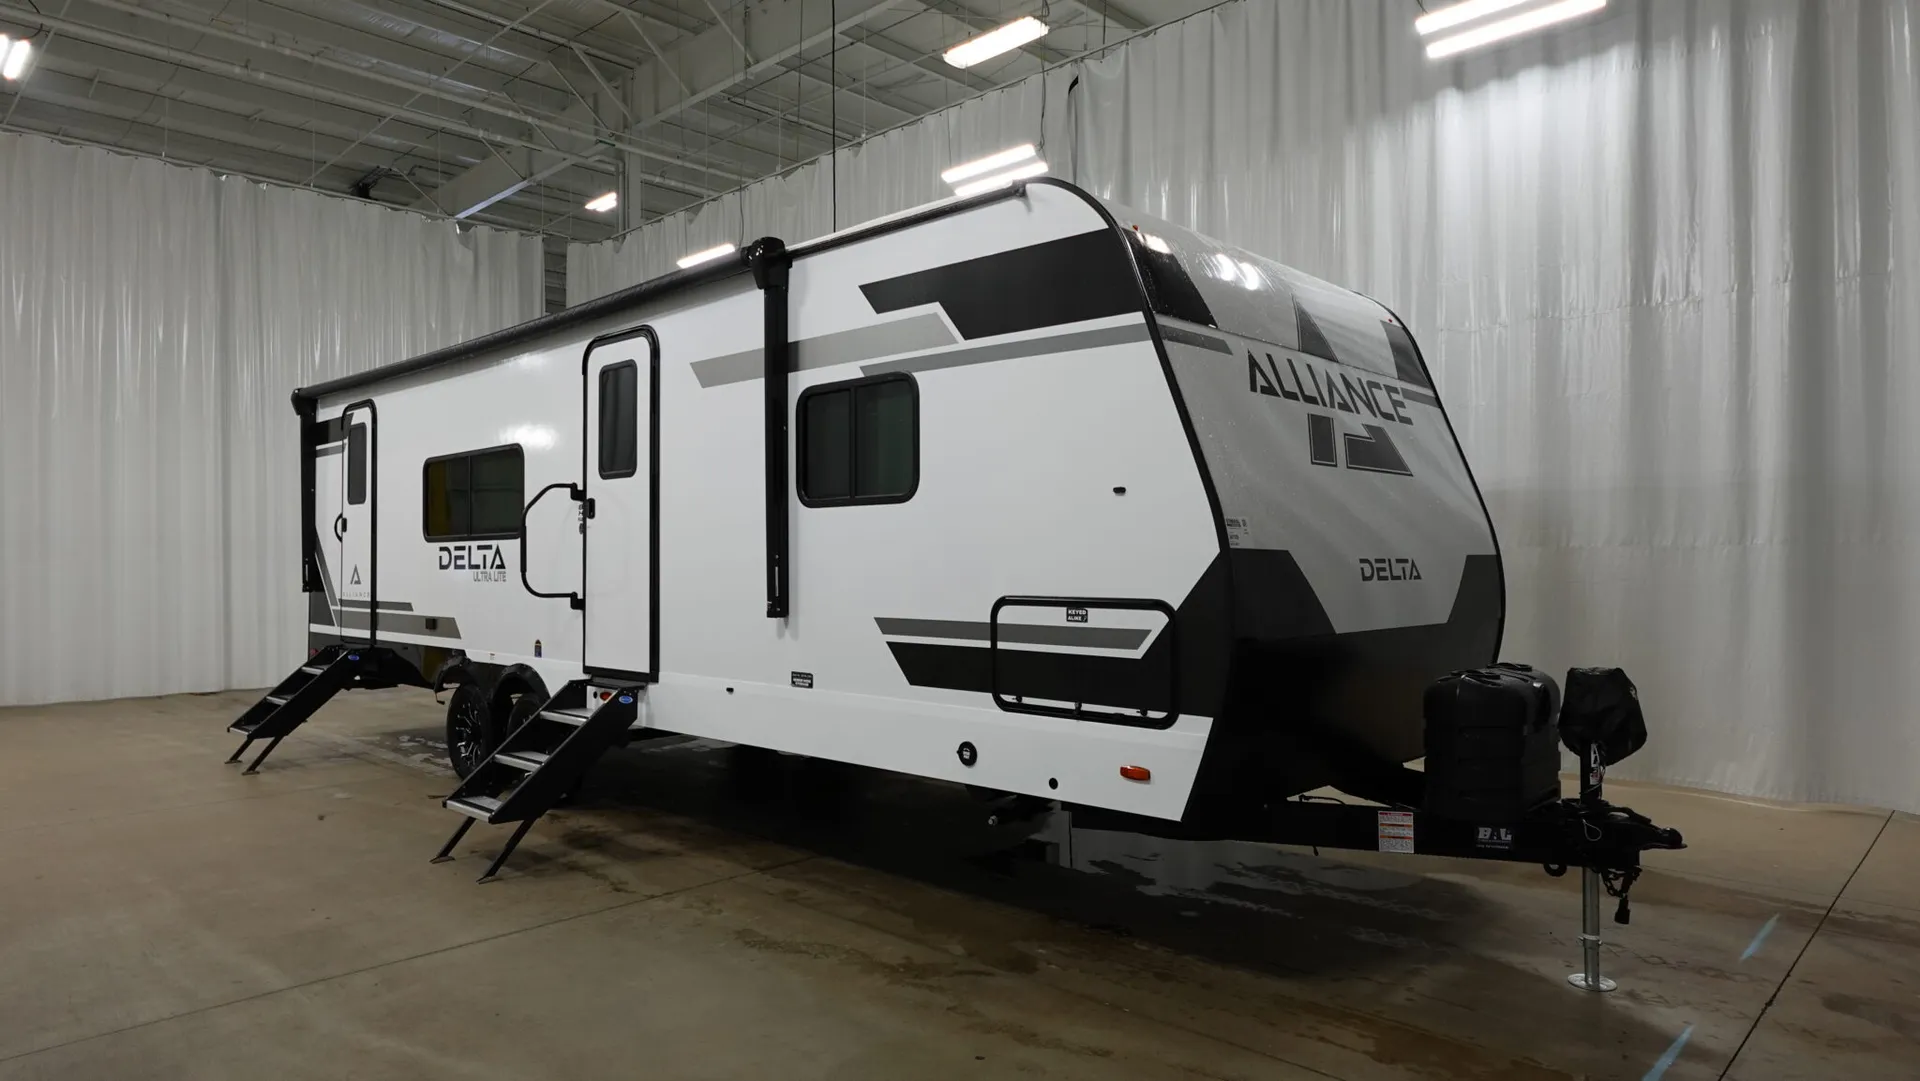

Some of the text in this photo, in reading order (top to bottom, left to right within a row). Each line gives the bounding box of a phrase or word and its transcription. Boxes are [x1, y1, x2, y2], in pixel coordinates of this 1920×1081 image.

[1247, 348, 1414, 426] ALLIANCE
[438, 543, 506, 570] DELTA
[1358, 557, 1423, 582] DELTA
[473, 571, 507, 582] ULTRA LITE
